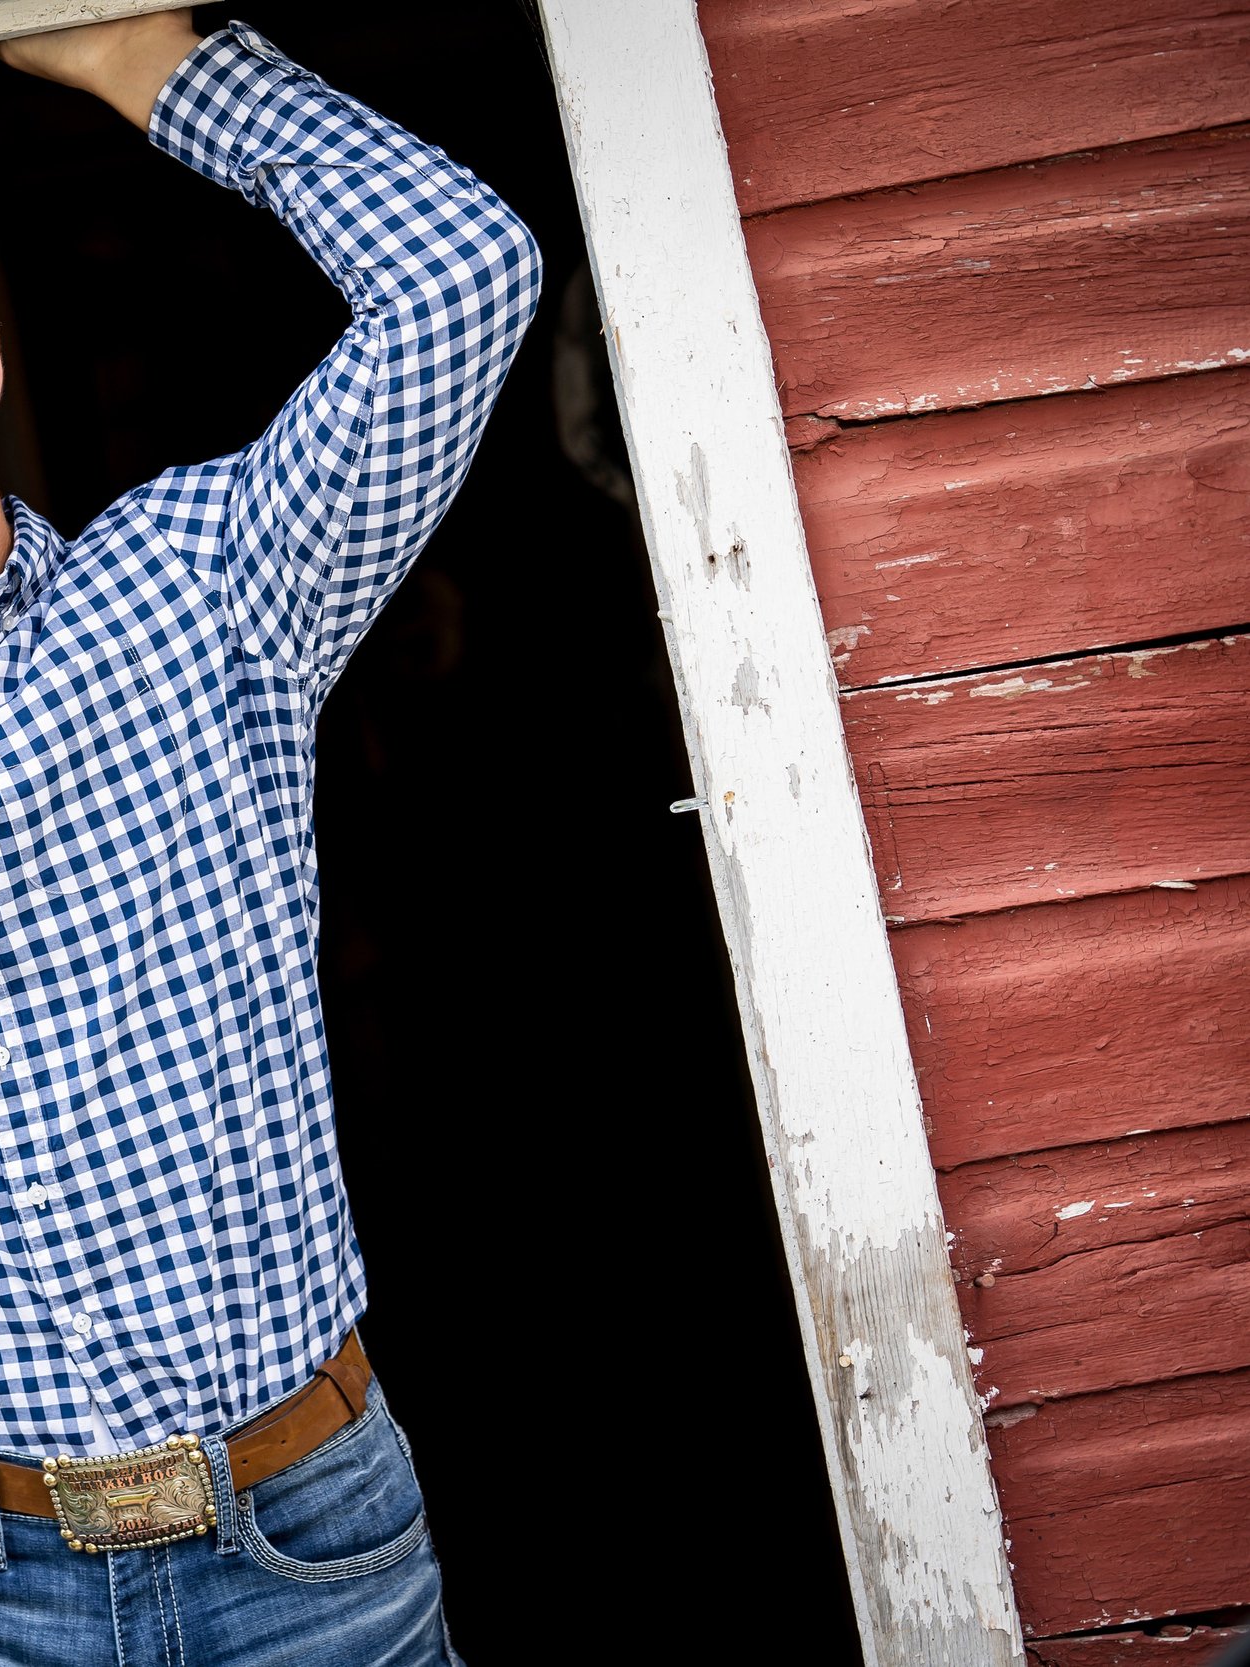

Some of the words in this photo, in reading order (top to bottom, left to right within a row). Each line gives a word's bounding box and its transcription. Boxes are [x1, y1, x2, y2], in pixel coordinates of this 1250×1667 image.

[59, 1469, 106, 1482] GRAND
[111, 1453, 185, 1478] CHAMPION
[69, 1476, 135, 1492] MARKET
[141, 1466, 178, 1484] HOG
[117, 1517, 150, 1532] 2017
[117, 1524, 170, 1542] COUNTY
[172, 1514, 204, 1531] FAIR
